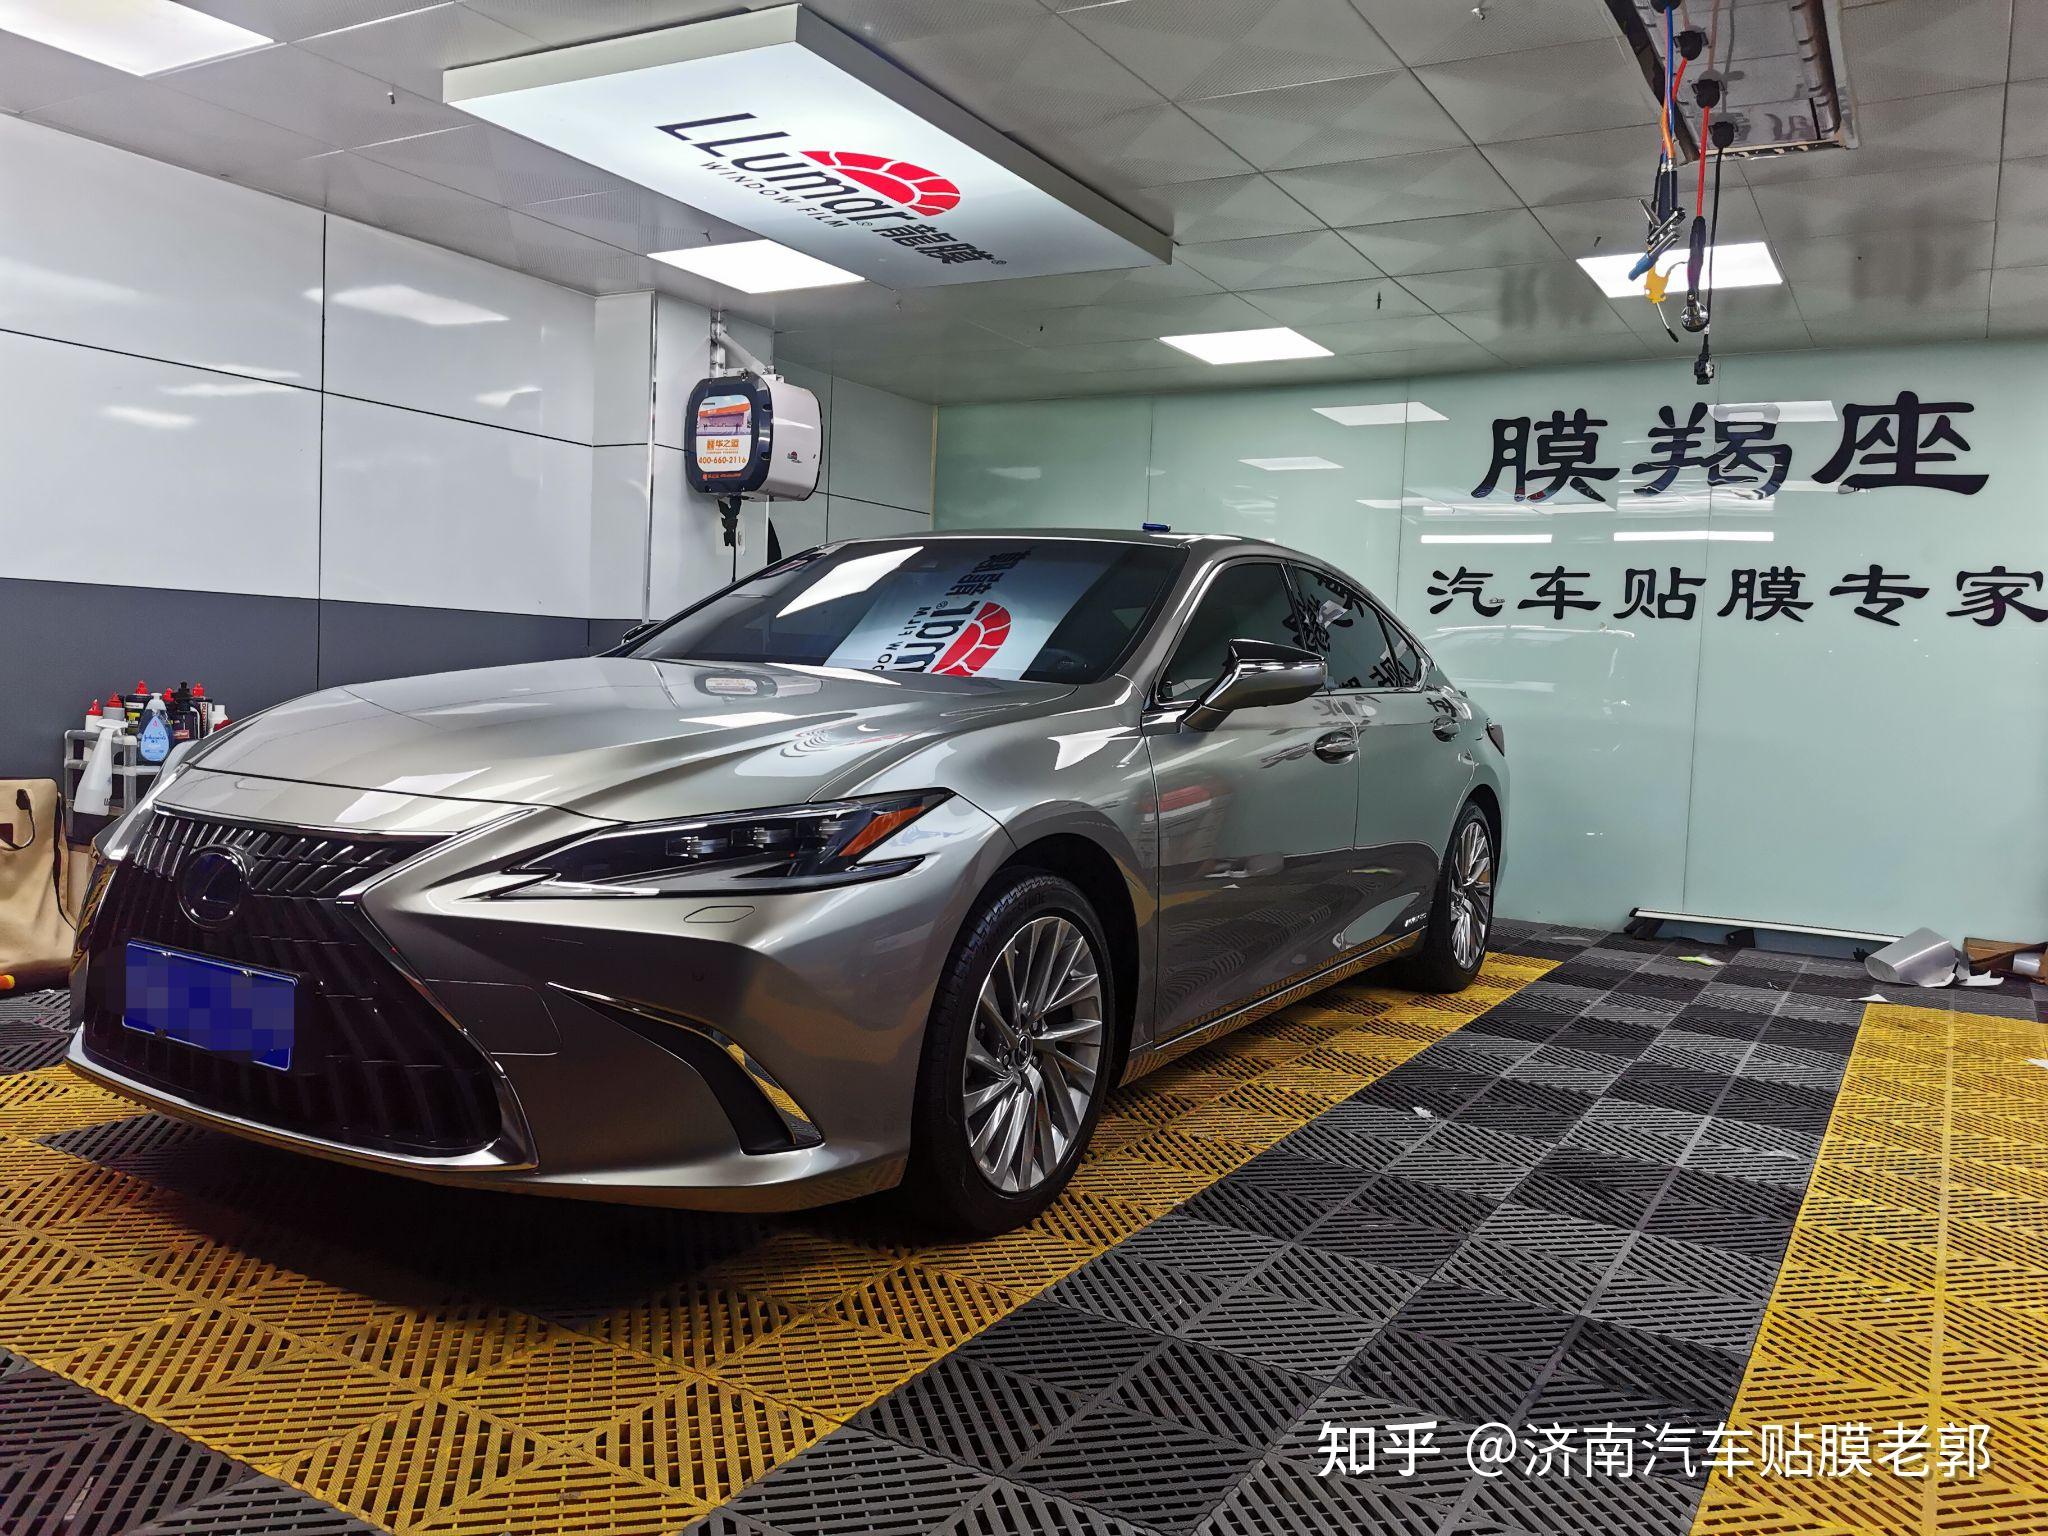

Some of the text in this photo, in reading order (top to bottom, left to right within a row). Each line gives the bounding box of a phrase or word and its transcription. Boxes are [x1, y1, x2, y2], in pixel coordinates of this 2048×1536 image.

[654, 112, 918, 221] LLumar
[700, 161, 849, 228] WINDOW FILM
[699, 456, 747, 464] 400-660-2116
[1471, 390, 1990, 503] 膜羯座
[1426, 564, 2048, 627] 汽车贴膜专家
